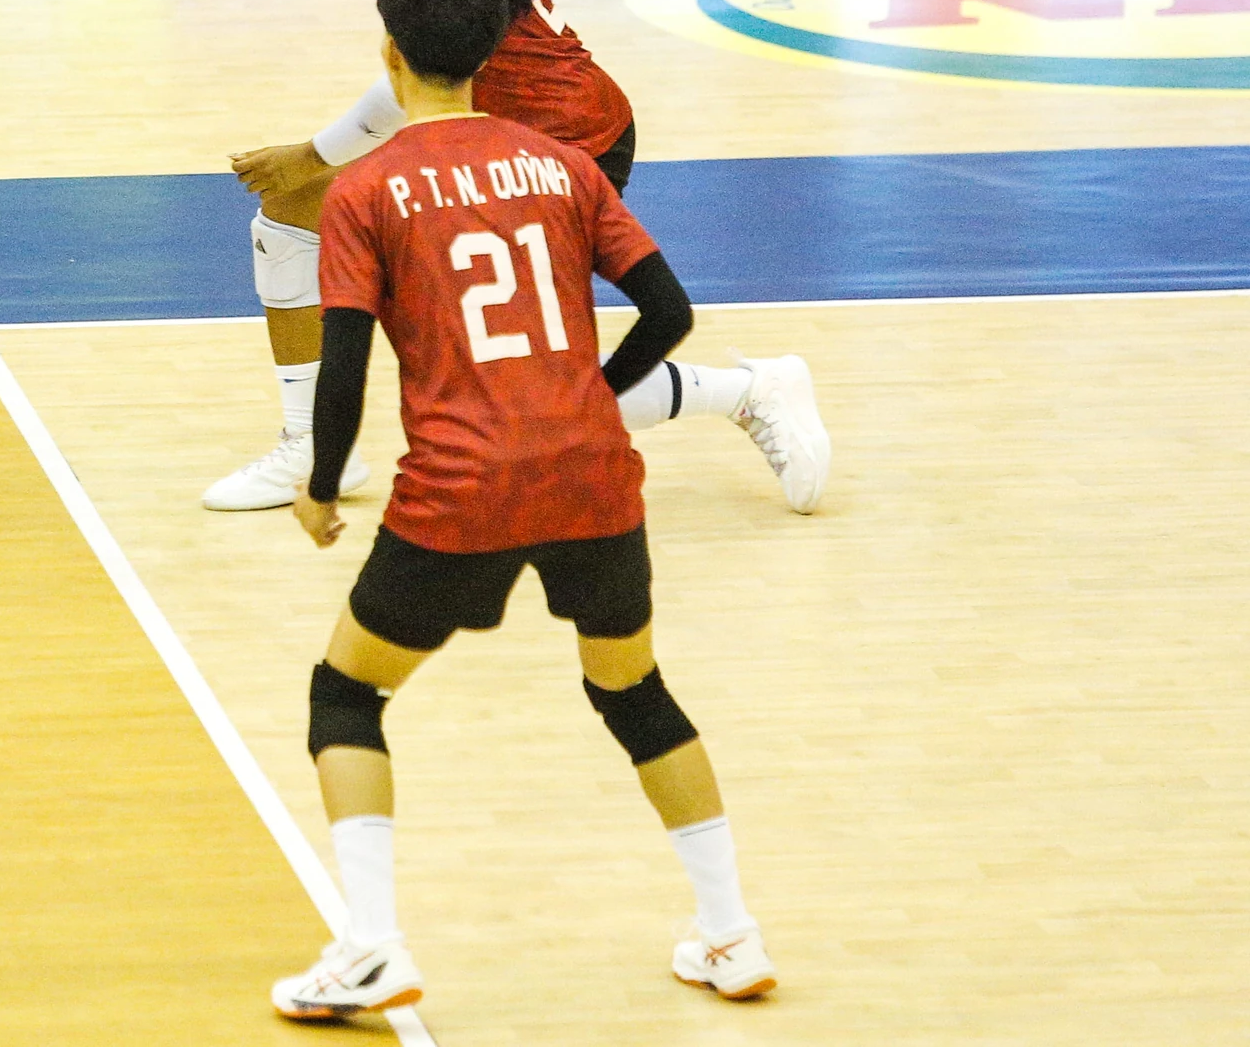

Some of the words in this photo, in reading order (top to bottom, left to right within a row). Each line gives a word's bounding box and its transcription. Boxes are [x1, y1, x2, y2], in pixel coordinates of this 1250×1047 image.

[387, 176, 422, 219] P.
[420, 167, 454, 208] T.
[452, 165, 487, 206] N.
[487, 148, 572, 200] QUỲNH
[448, 221, 569, 364] 21
